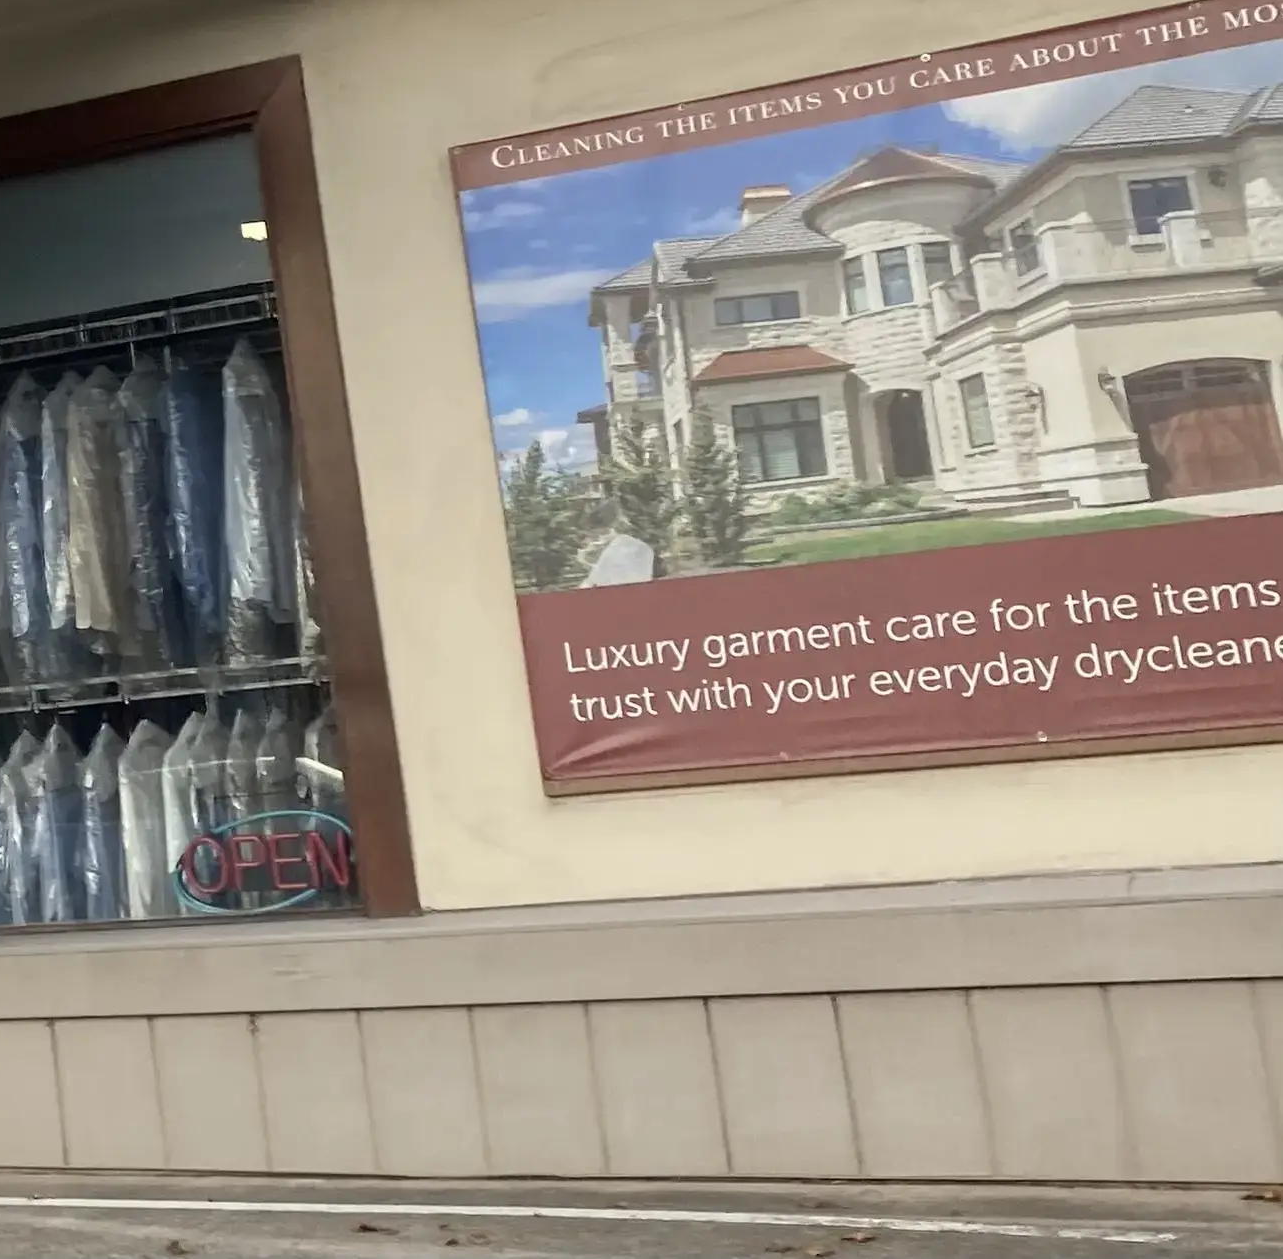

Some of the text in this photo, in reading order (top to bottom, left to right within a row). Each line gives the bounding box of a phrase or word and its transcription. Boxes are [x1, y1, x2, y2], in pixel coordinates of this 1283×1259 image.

[655, 111, 717, 139] THE
[727, 90, 823, 126] ITEMS
[833, 74, 897, 105] YOU
[908, 57, 996, 91] CARE
[1008, 31, 1126, 73] ABOUT
[1135, 15, 1210, 48] THE
[1221, 3, 1283, 32] MO
[563, 578, 1282, 673] Luxury garment care for the items
[569, 686, 659, 722] trust
[665, 676, 753, 714] with
[761, 672, 857, 715] your
[868, 652, 1060, 698] everyday
[184, 830, 350, 894] OPEN
